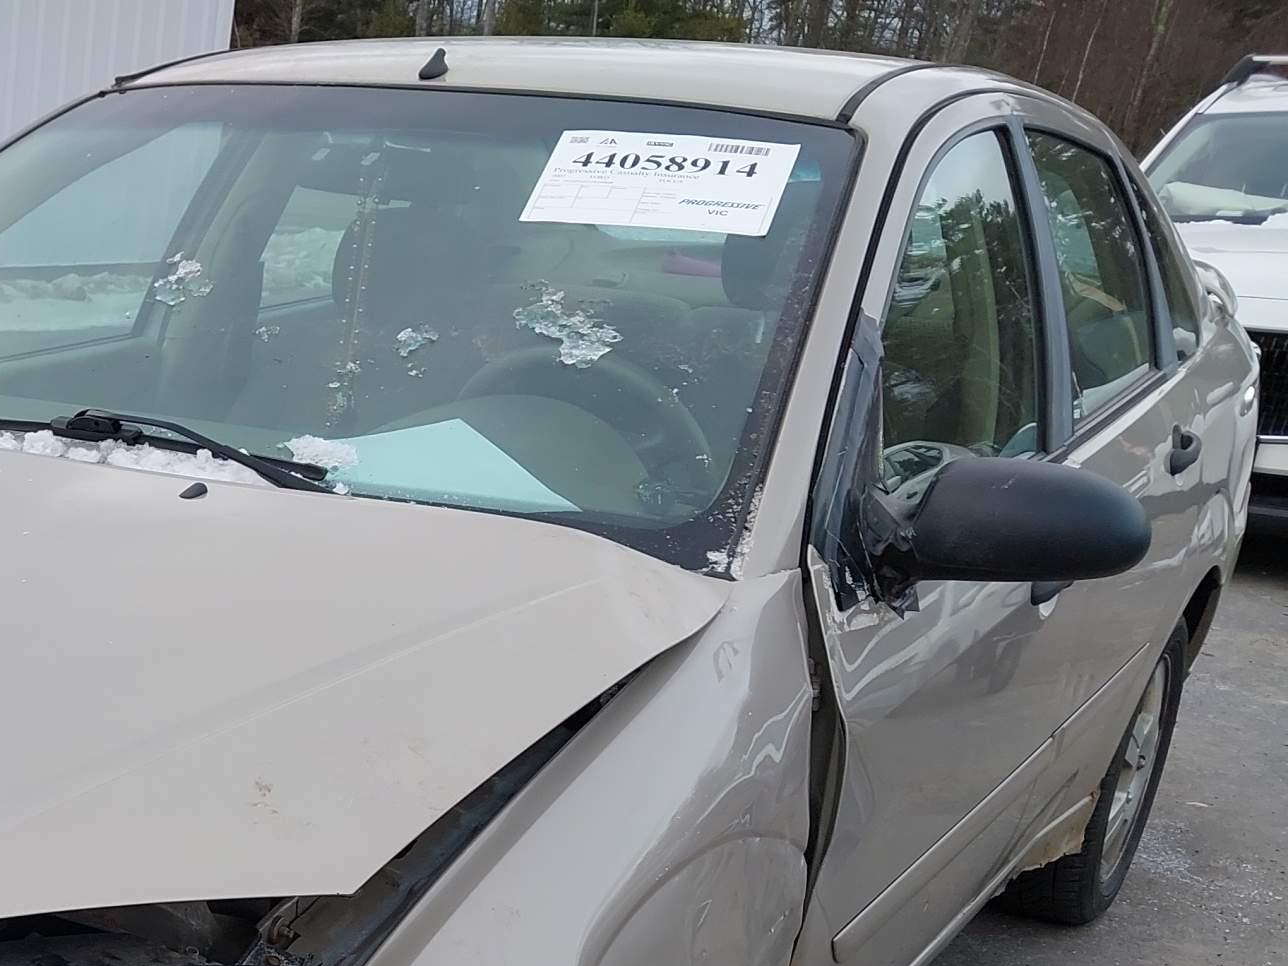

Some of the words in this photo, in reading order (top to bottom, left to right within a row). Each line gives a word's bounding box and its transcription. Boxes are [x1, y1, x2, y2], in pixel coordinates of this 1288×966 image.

[572, 151, 758, 178] 44058914
[553, 167, 608, 176] Progressive
[678, 198, 763, 210] PROGRESSIVE
[707, 209, 729, 217] VIC
